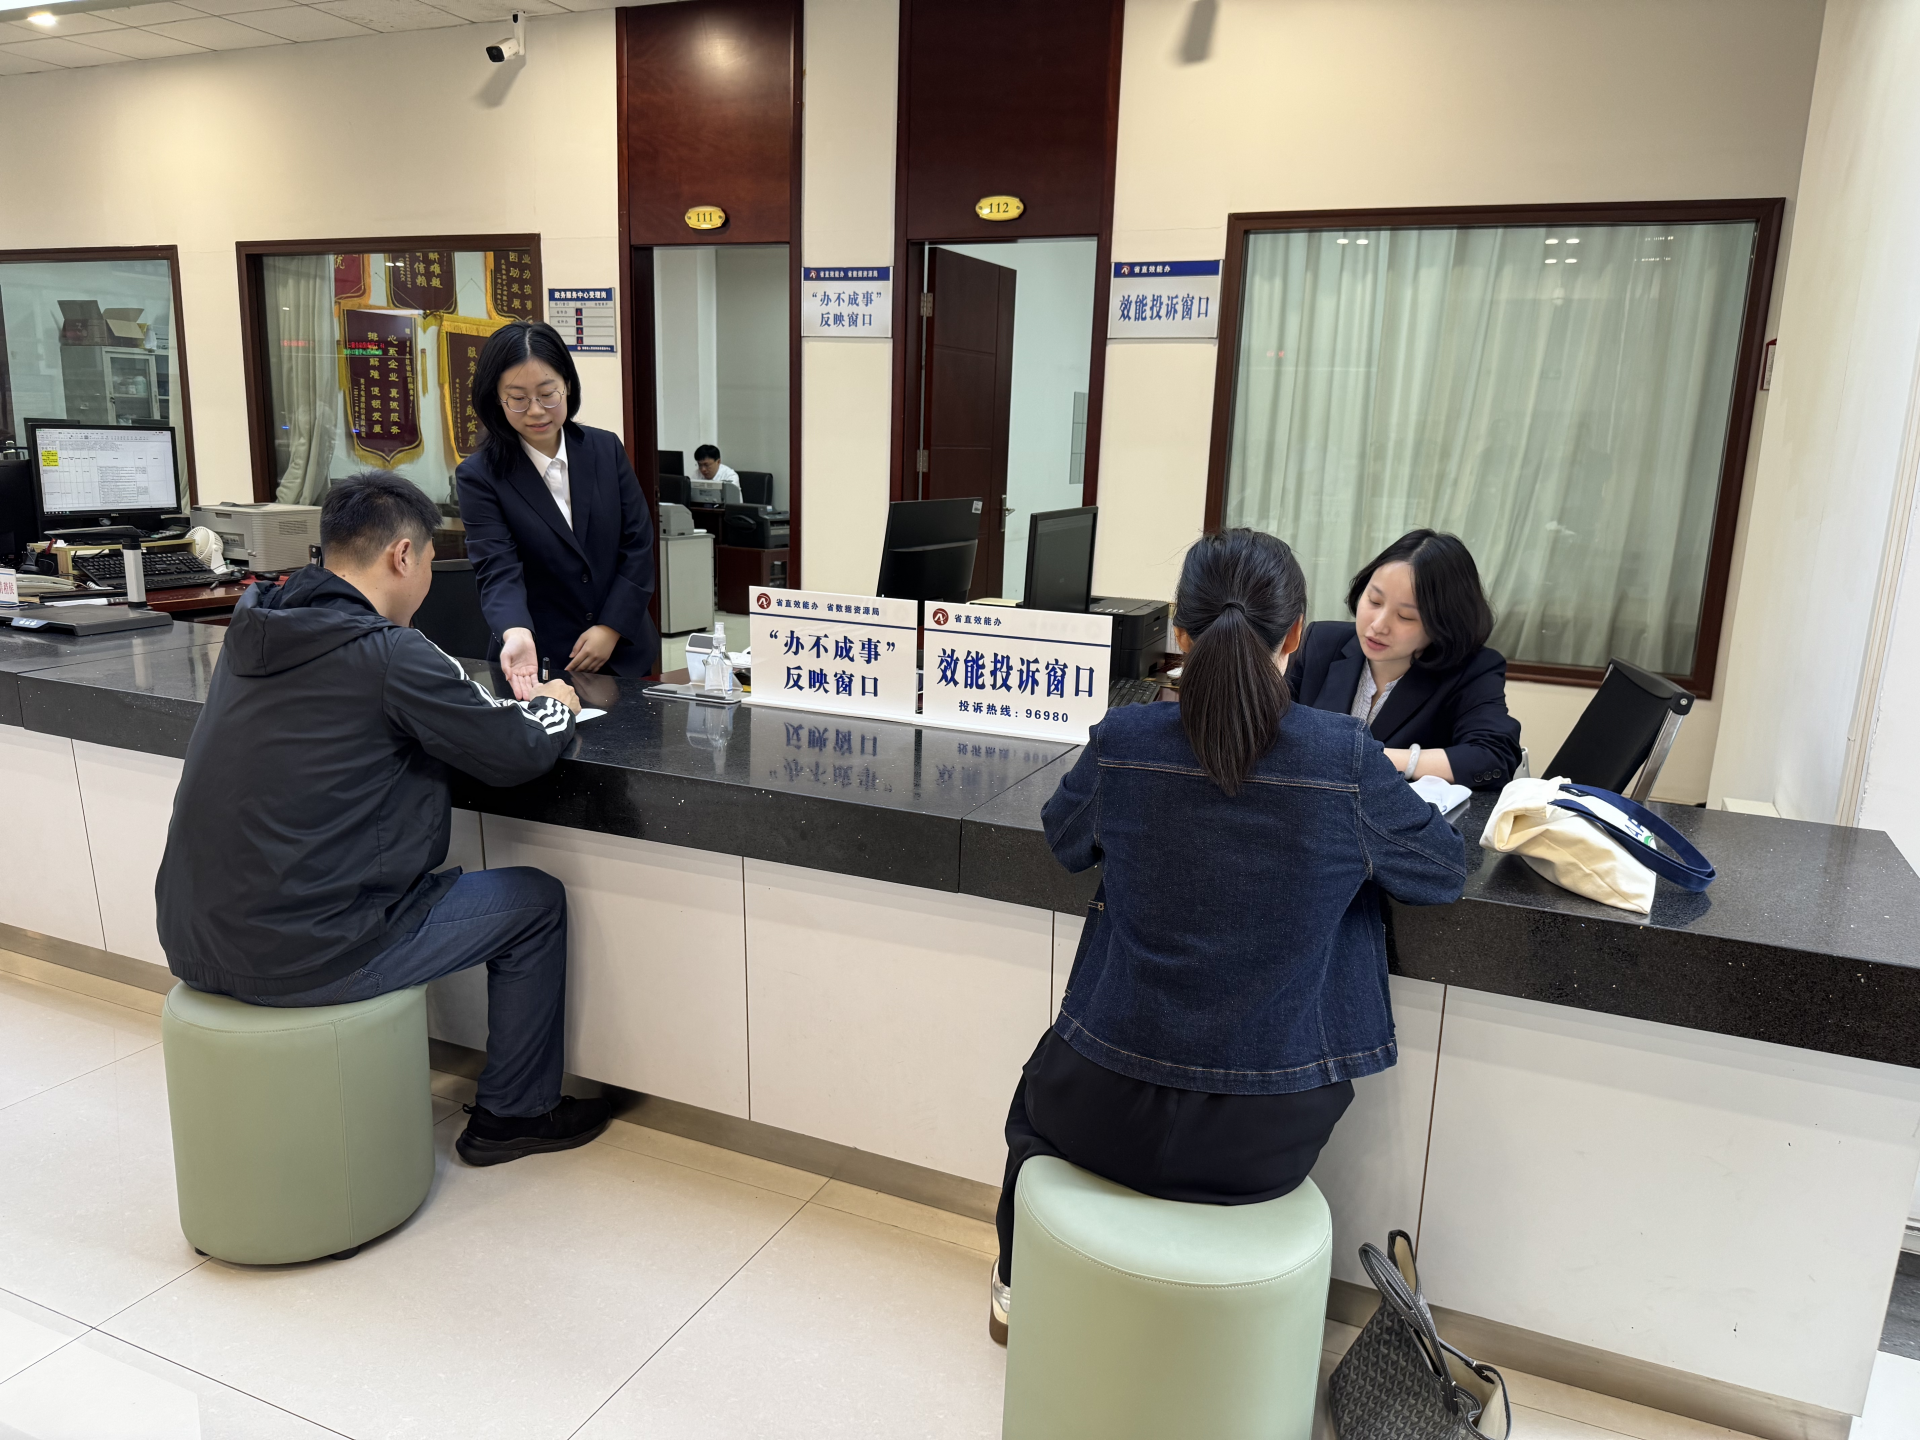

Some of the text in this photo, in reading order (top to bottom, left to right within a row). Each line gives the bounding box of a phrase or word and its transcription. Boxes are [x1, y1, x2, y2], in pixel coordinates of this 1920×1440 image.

[988, 202, 1010, 214] 112
[696, 212, 714, 223] 111
[1133, 264, 1171, 274] 省直效能办
[812, 290, 882, 307] “办不成事”
[1118, 293, 1210, 322] 效能投诉窗口
[819, 311, 872, 328] 反映窗口
[776, 598, 880, 617] 省直效能办 省数据资源局
[954, 613, 1002, 627] 省直效能办
[769, 629, 896, 665] “办不成事”
[783, 665, 879, 697] 反映窗口
[936, 647, 1095, 699] 效能投诉窗口
